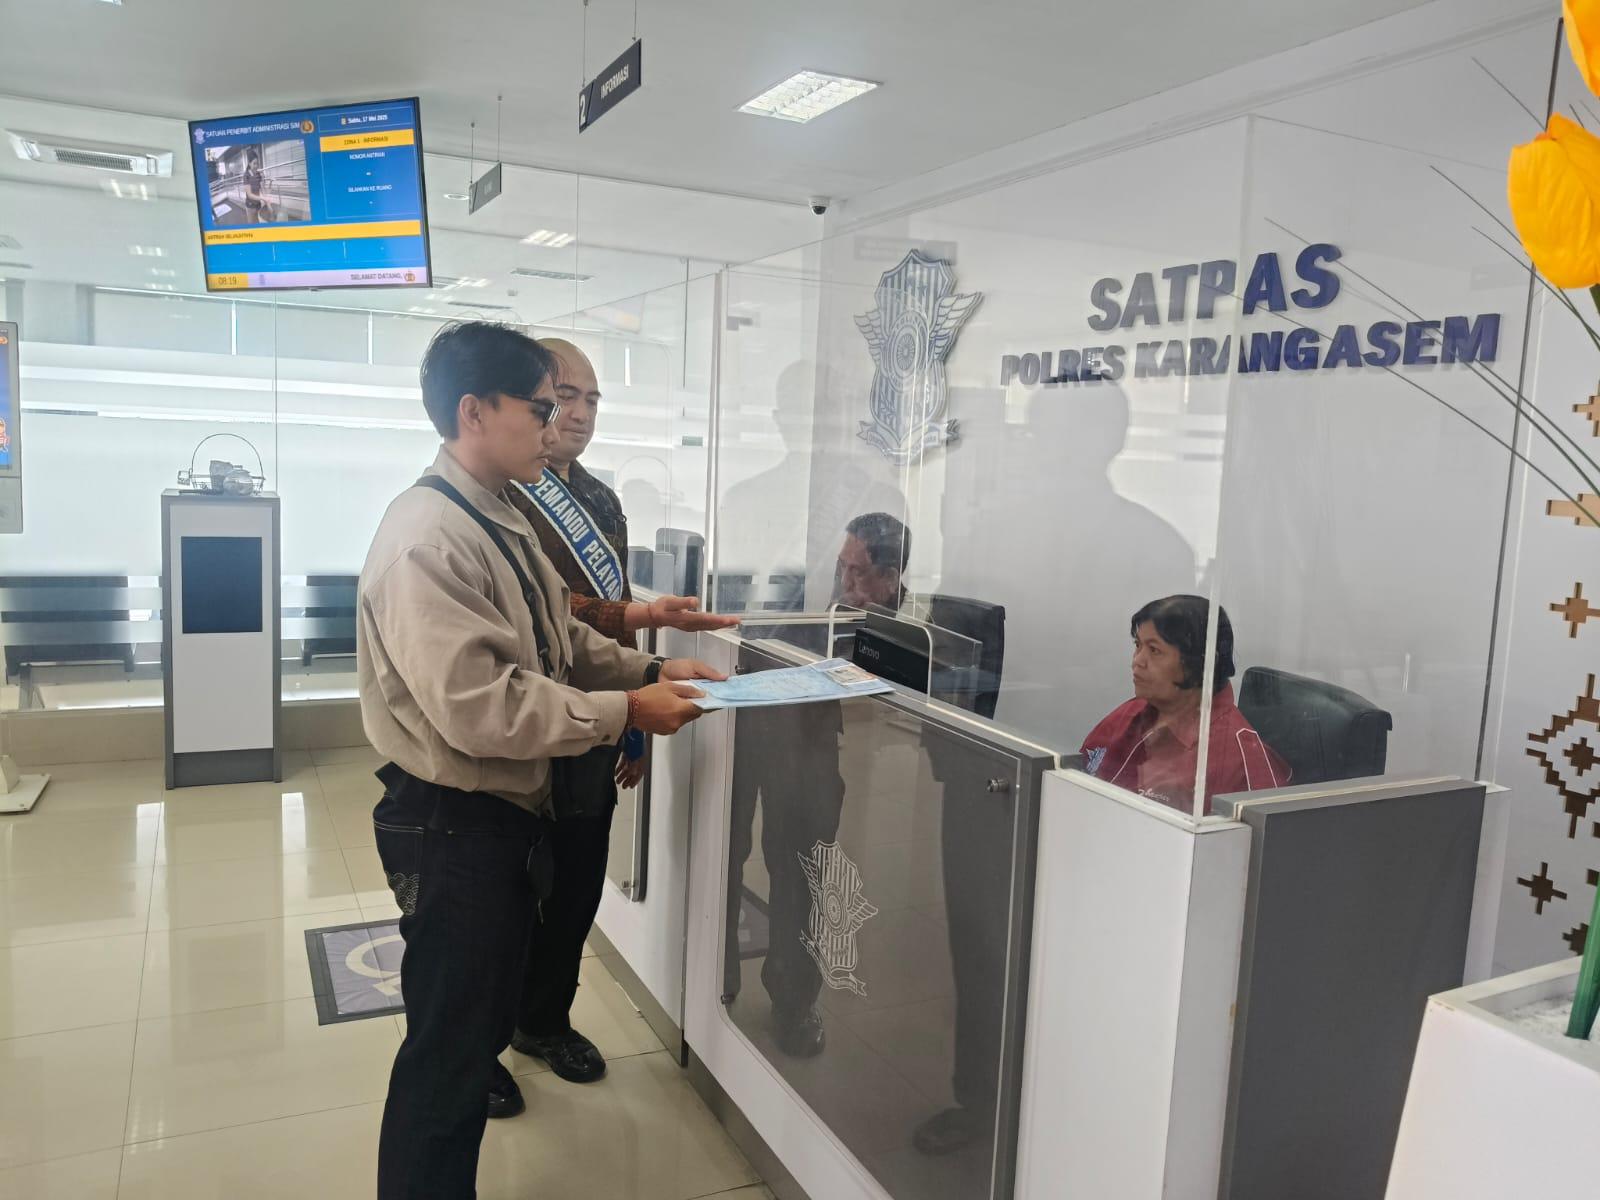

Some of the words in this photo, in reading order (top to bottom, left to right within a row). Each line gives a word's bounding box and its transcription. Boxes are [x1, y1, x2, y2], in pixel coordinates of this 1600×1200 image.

[580, 94, 586, 126] 2
[601, 64, 629, 100] INFORMASI
[227, 127, 252, 135] PENERBIT
[252, 123, 289, 132] ADMINISTRASI
[1087, 243, 1342, 331] SATPAS
[1000, 344, 1126, 386] POLRES
[1133, 313, 1502, 379] KARANGASEM
[858, 640, 880, 660] Lenovo
